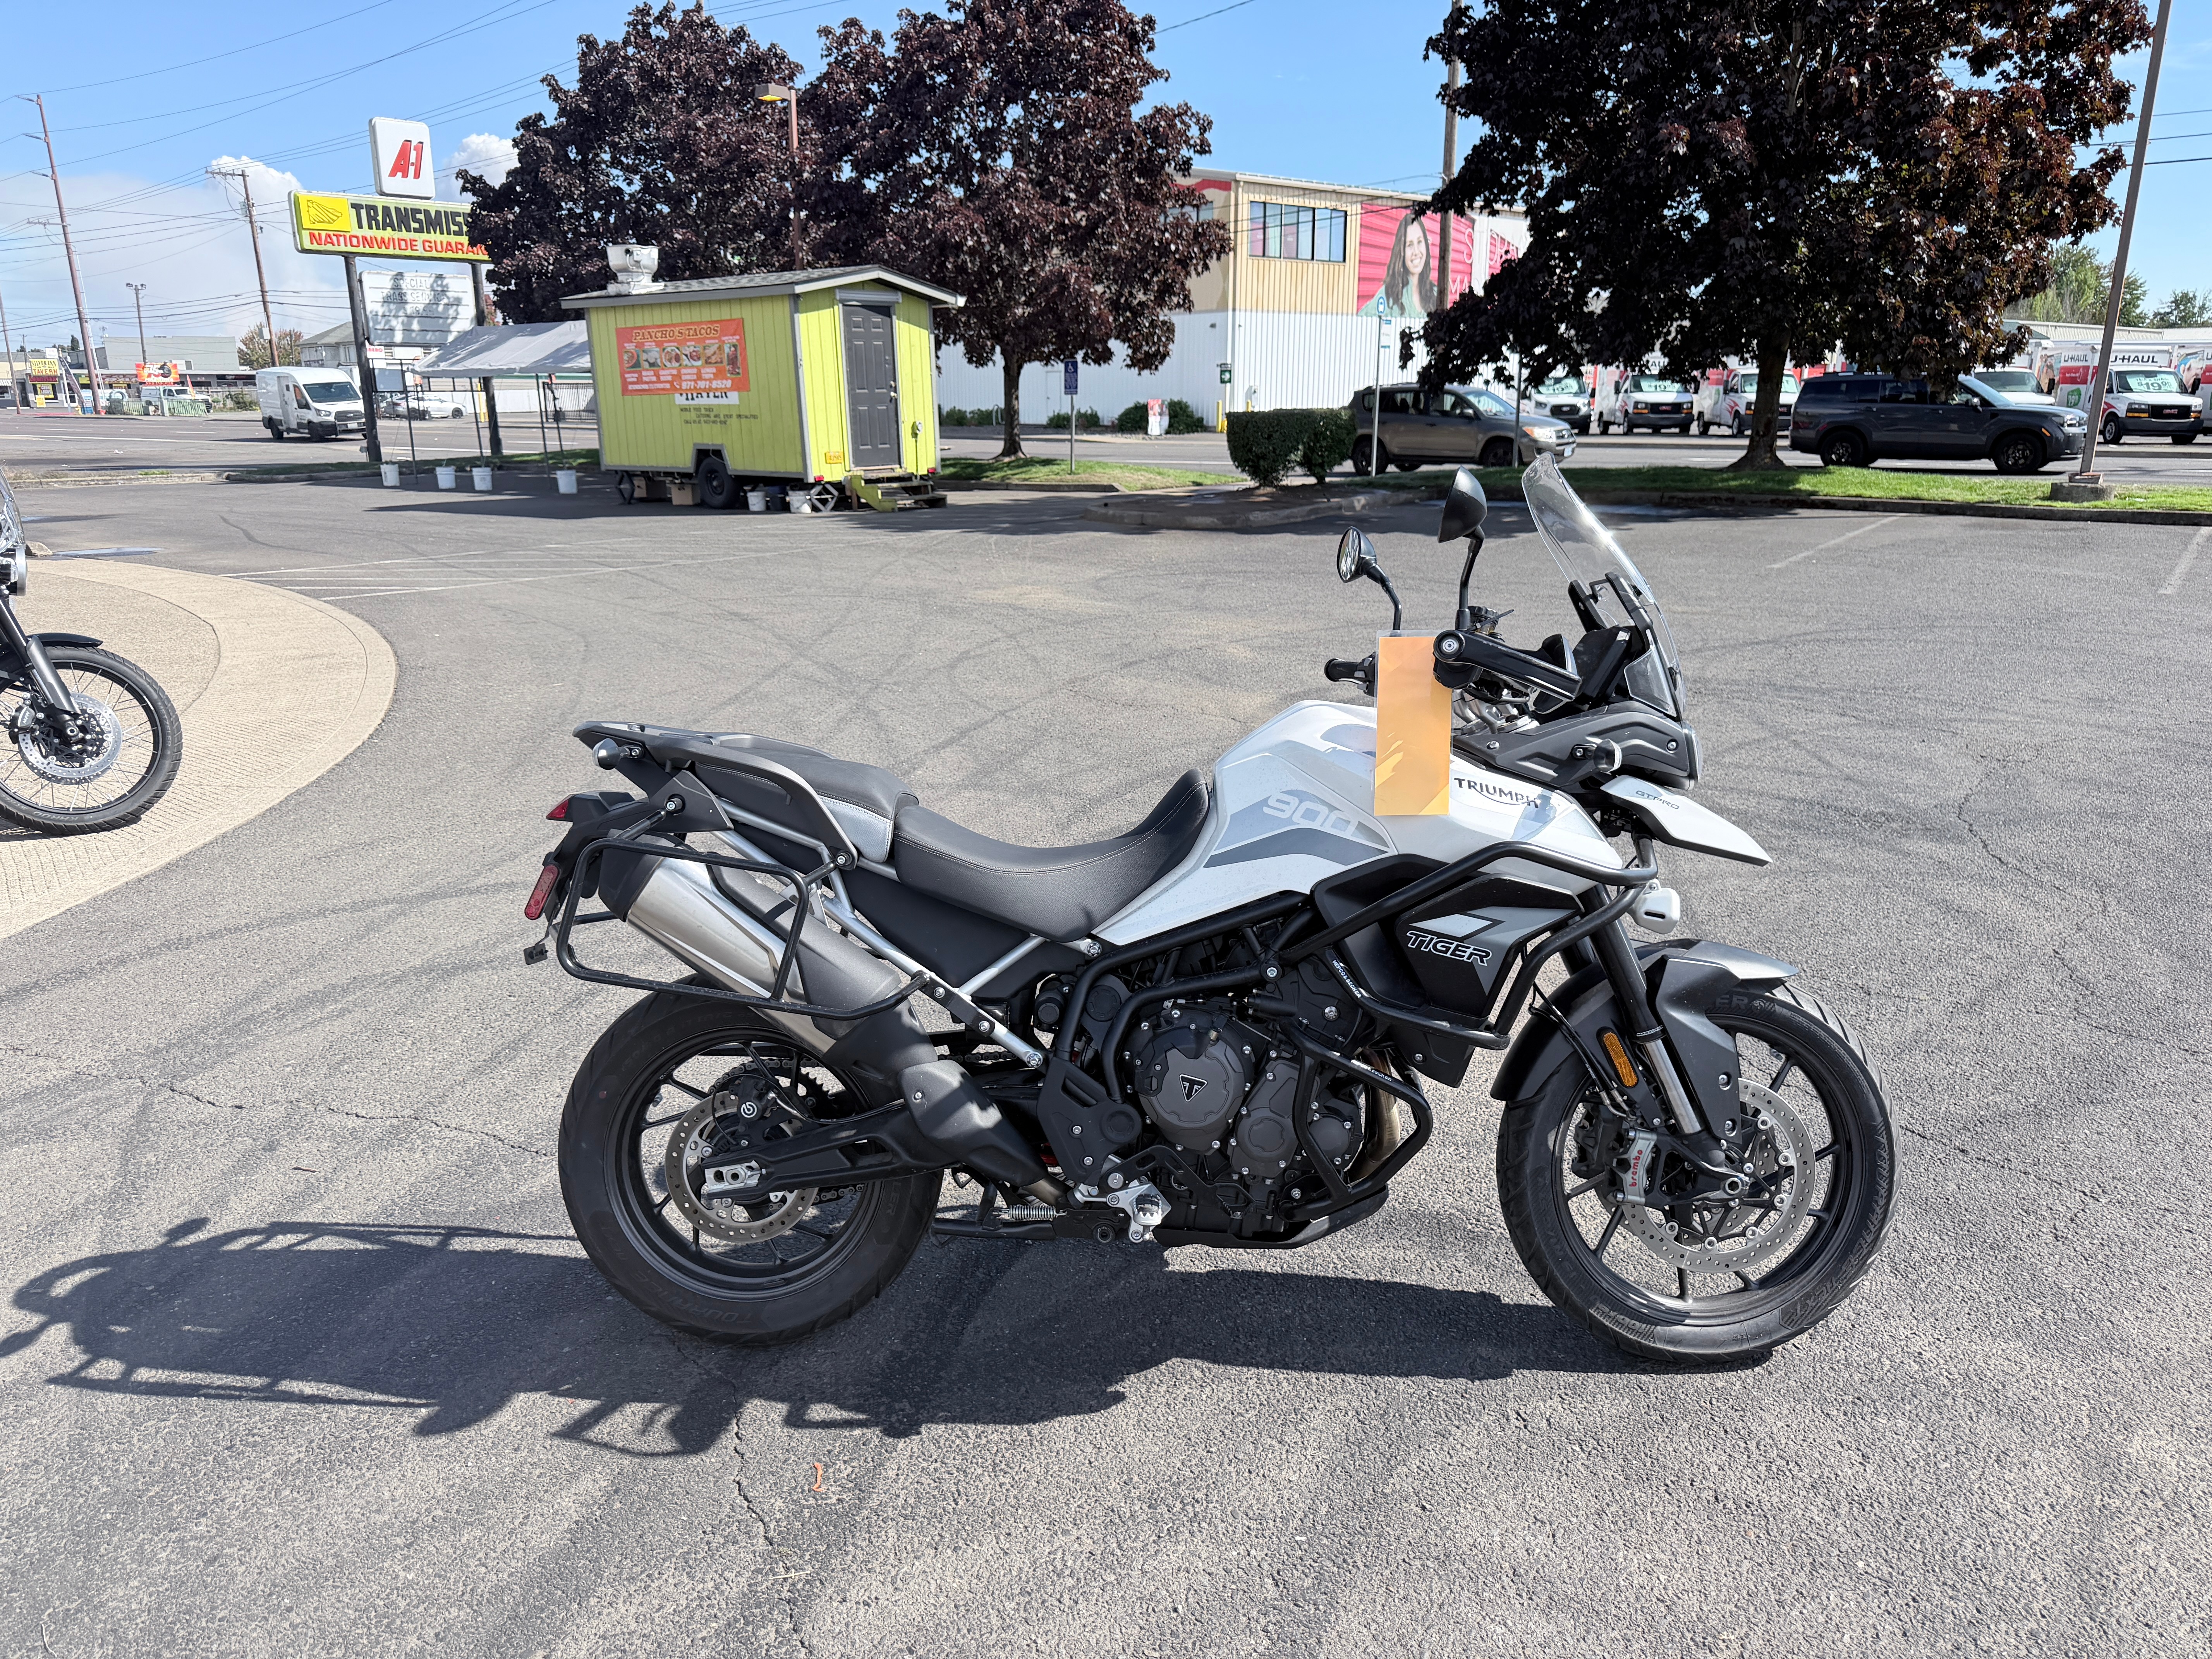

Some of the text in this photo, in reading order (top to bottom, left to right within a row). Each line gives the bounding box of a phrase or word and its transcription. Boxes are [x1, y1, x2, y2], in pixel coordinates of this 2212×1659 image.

[309, 232, 419, 251] NATIONWIDE
[393, 277, 431, 289] SPECIAL
[686, 326, 719, 337] TACOS
[2064, 354, 2088, 362] U-HAUL
[1454, 778, 1539, 808] TRIUMPH
[1635, 790, 1680, 809] GT PRO
[1263, 793, 1358, 838] 900
[1407, 931, 1492, 966] TIGER
[1629, 1149, 1643, 1187] brembo
